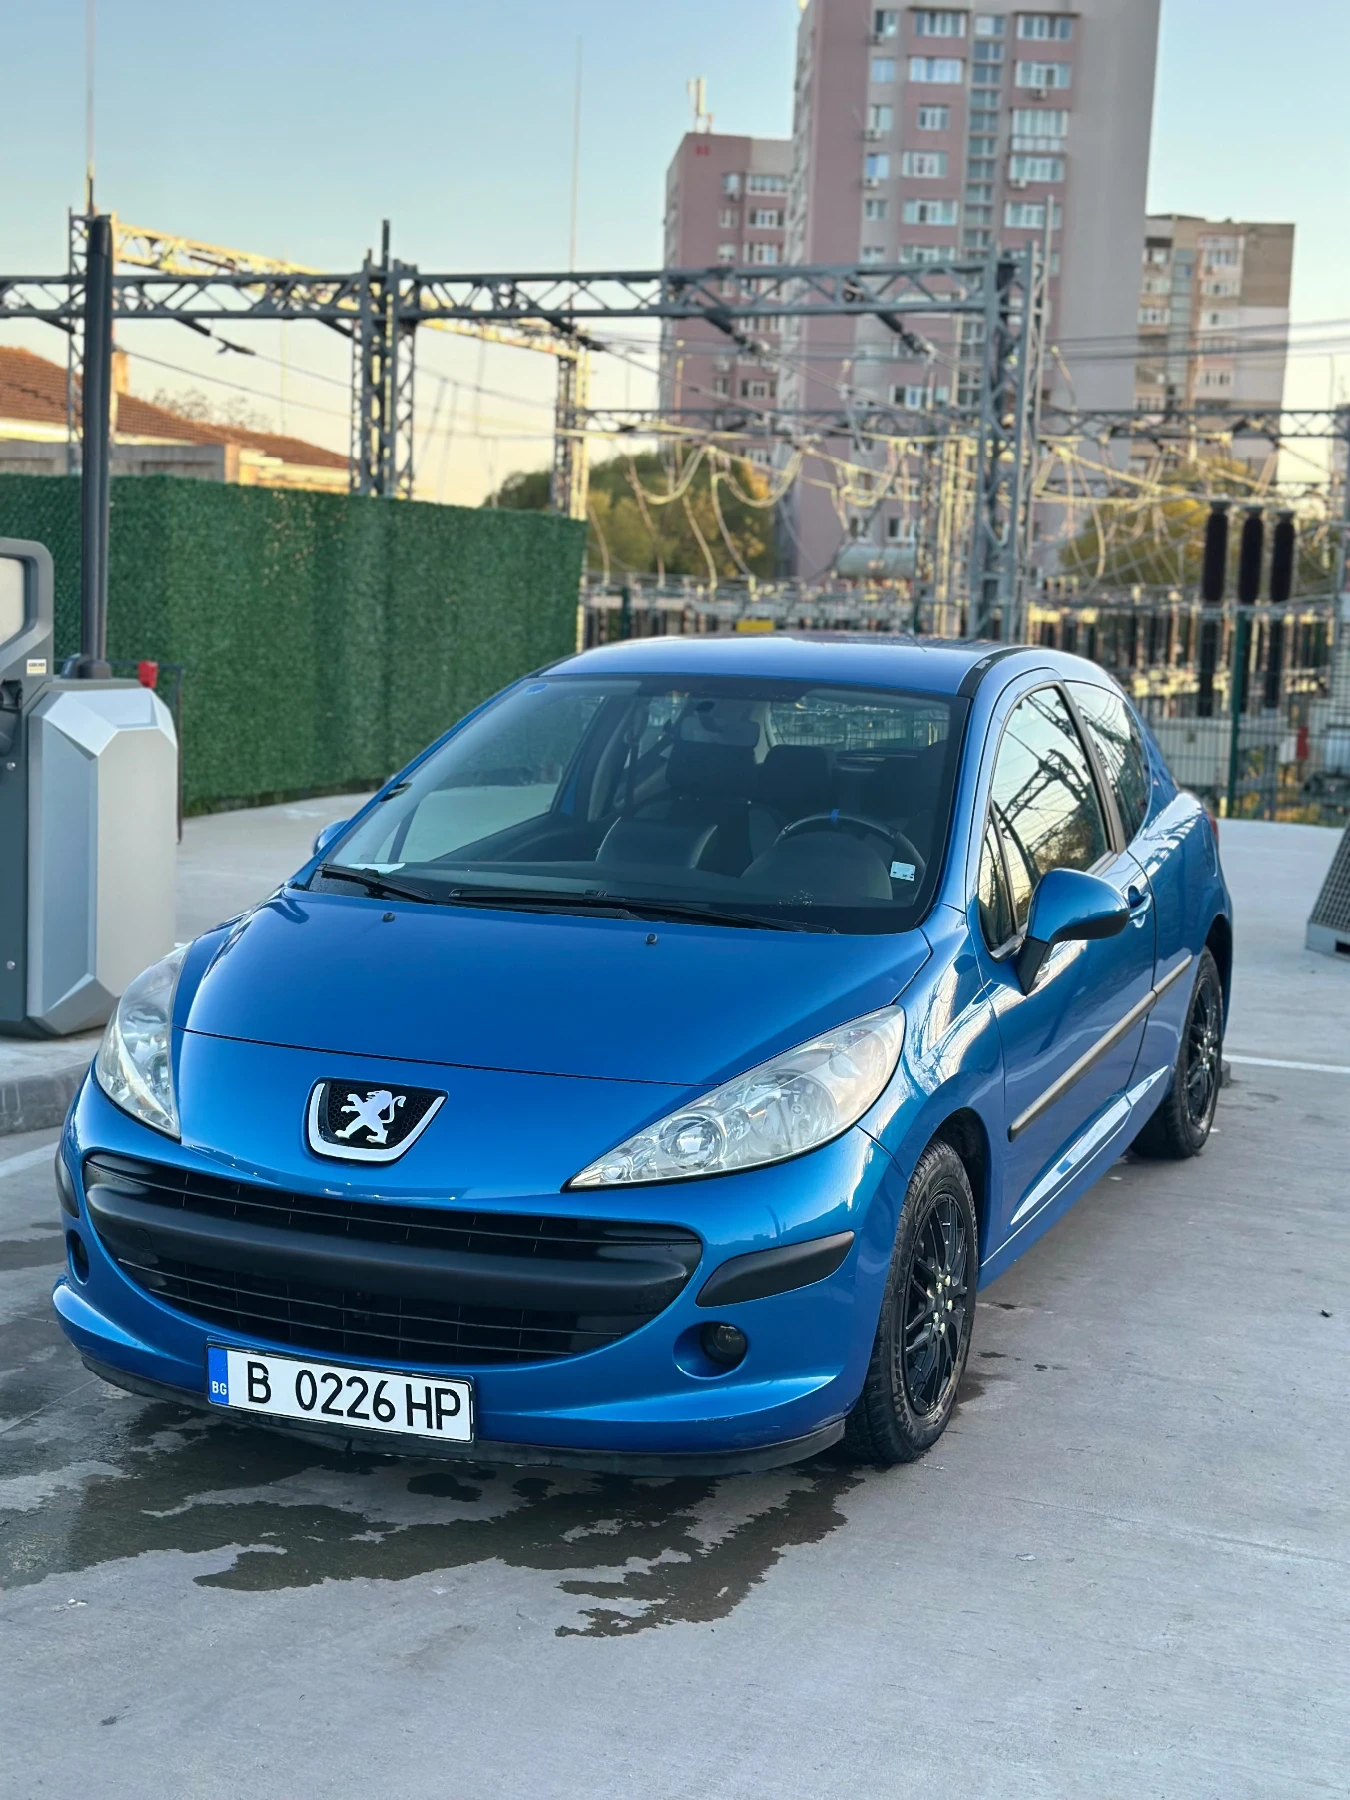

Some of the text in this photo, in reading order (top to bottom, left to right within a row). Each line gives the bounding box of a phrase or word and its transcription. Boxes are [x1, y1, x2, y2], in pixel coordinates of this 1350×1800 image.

[212, 1381, 227, 1395] BG
[247, 1361, 461, 1430] B 0226 HP
